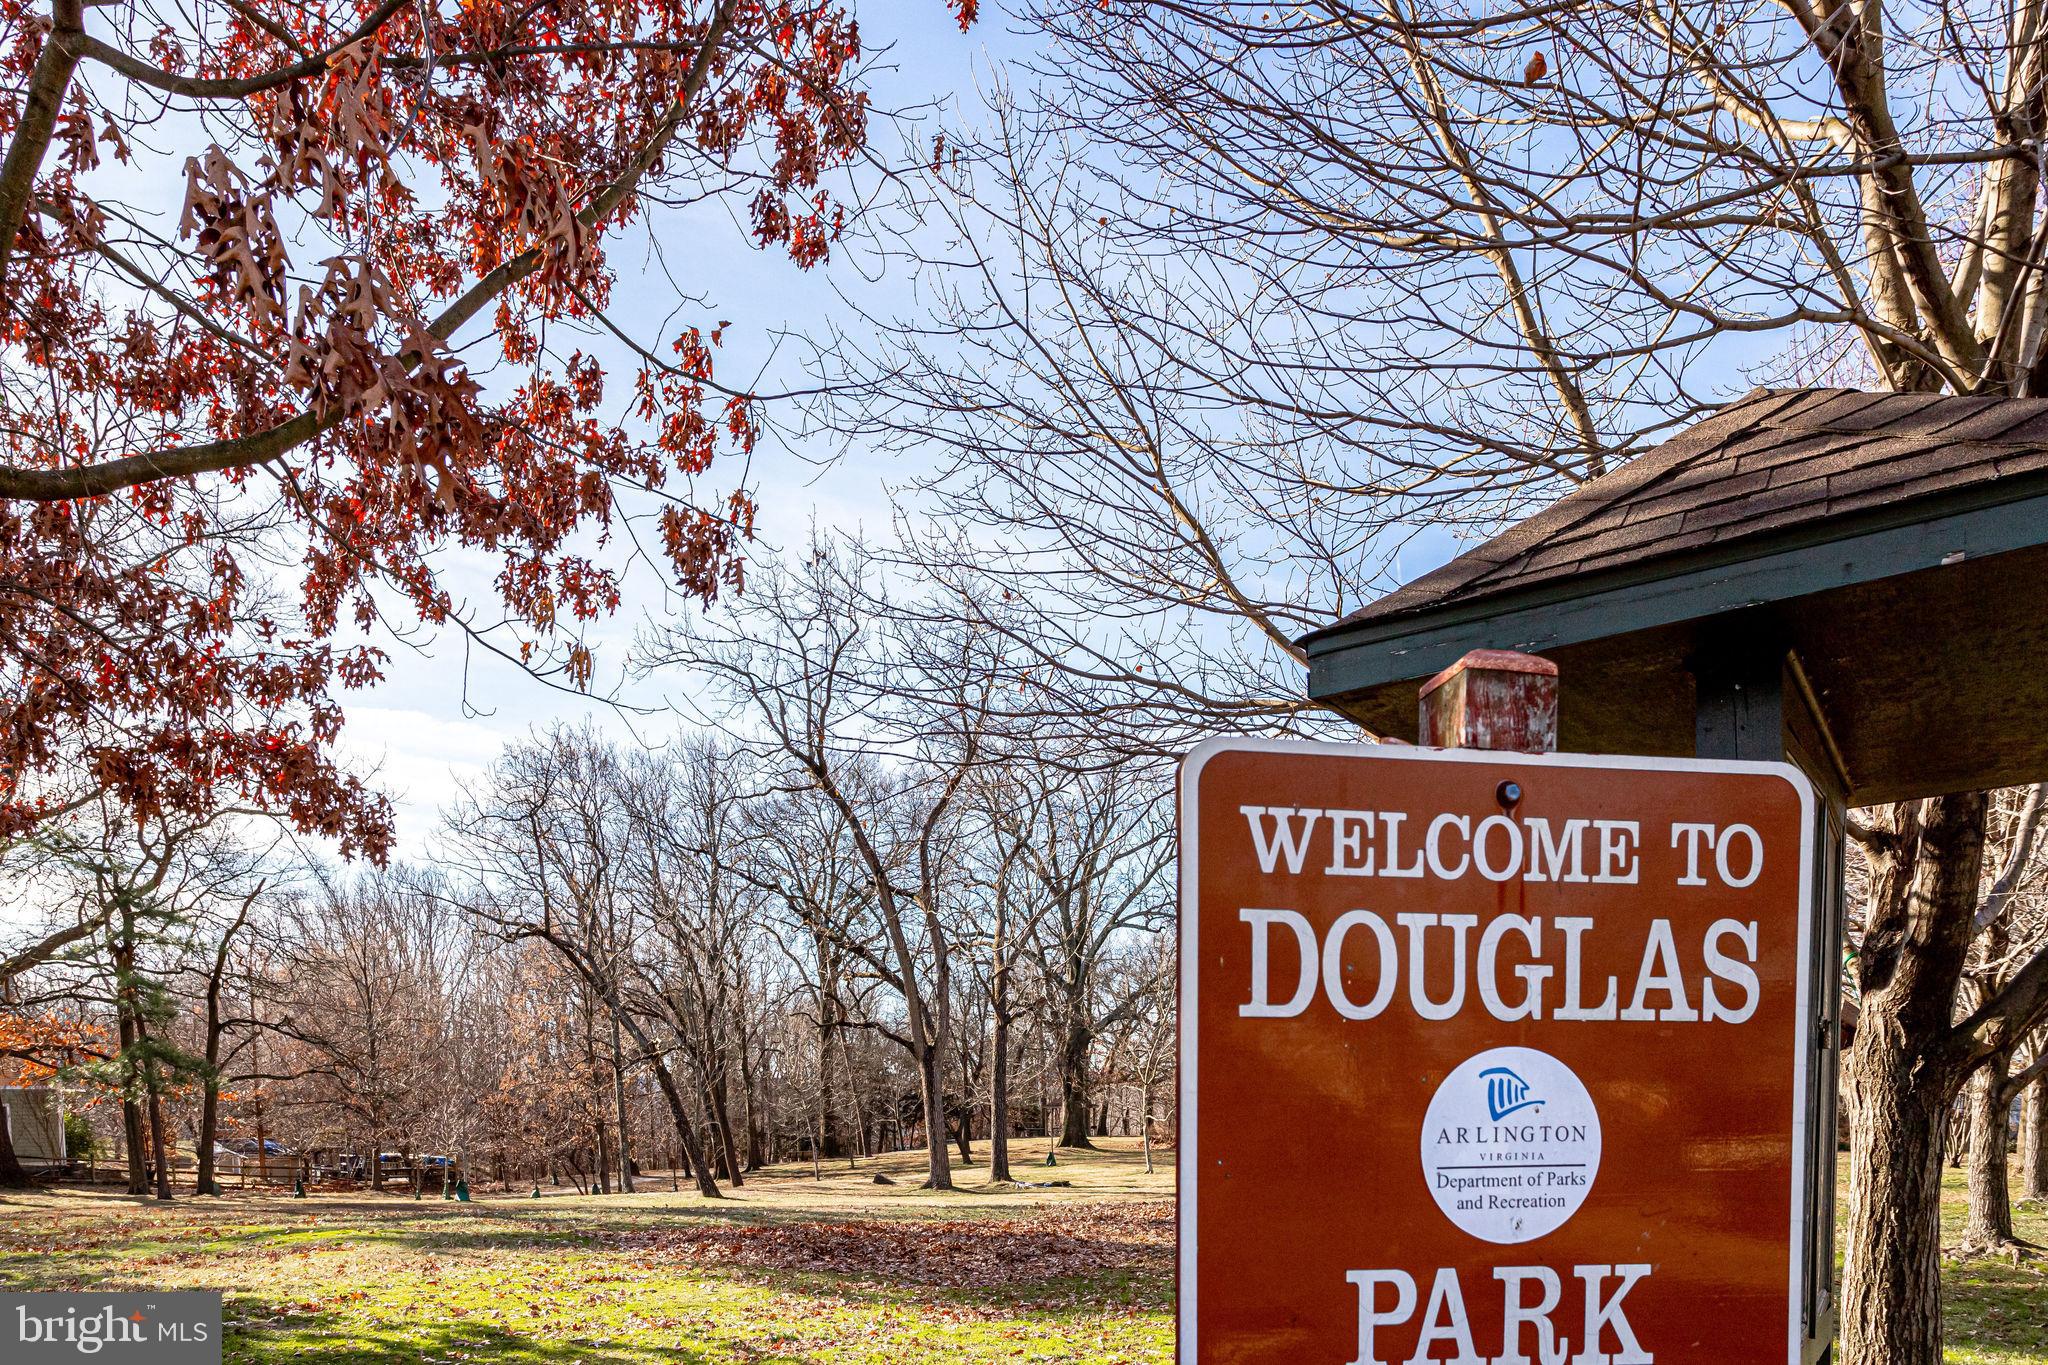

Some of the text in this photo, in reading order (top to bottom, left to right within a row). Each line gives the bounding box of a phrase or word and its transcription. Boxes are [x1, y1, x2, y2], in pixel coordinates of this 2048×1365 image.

[1239, 805, 1764, 888] WELCOME TO
[1239, 908, 1761, 1024] DOUGLAS
[1437, 1125, 1586, 1144] ARLINGTON
[1480, 1152, 1544, 1161] VIRGINIA
[1437, 1171, 1586, 1192] Department of Parks
[1456, 1194, 1566, 1210] and Recreation
[1345, 1263, 1654, 1365] PARK
